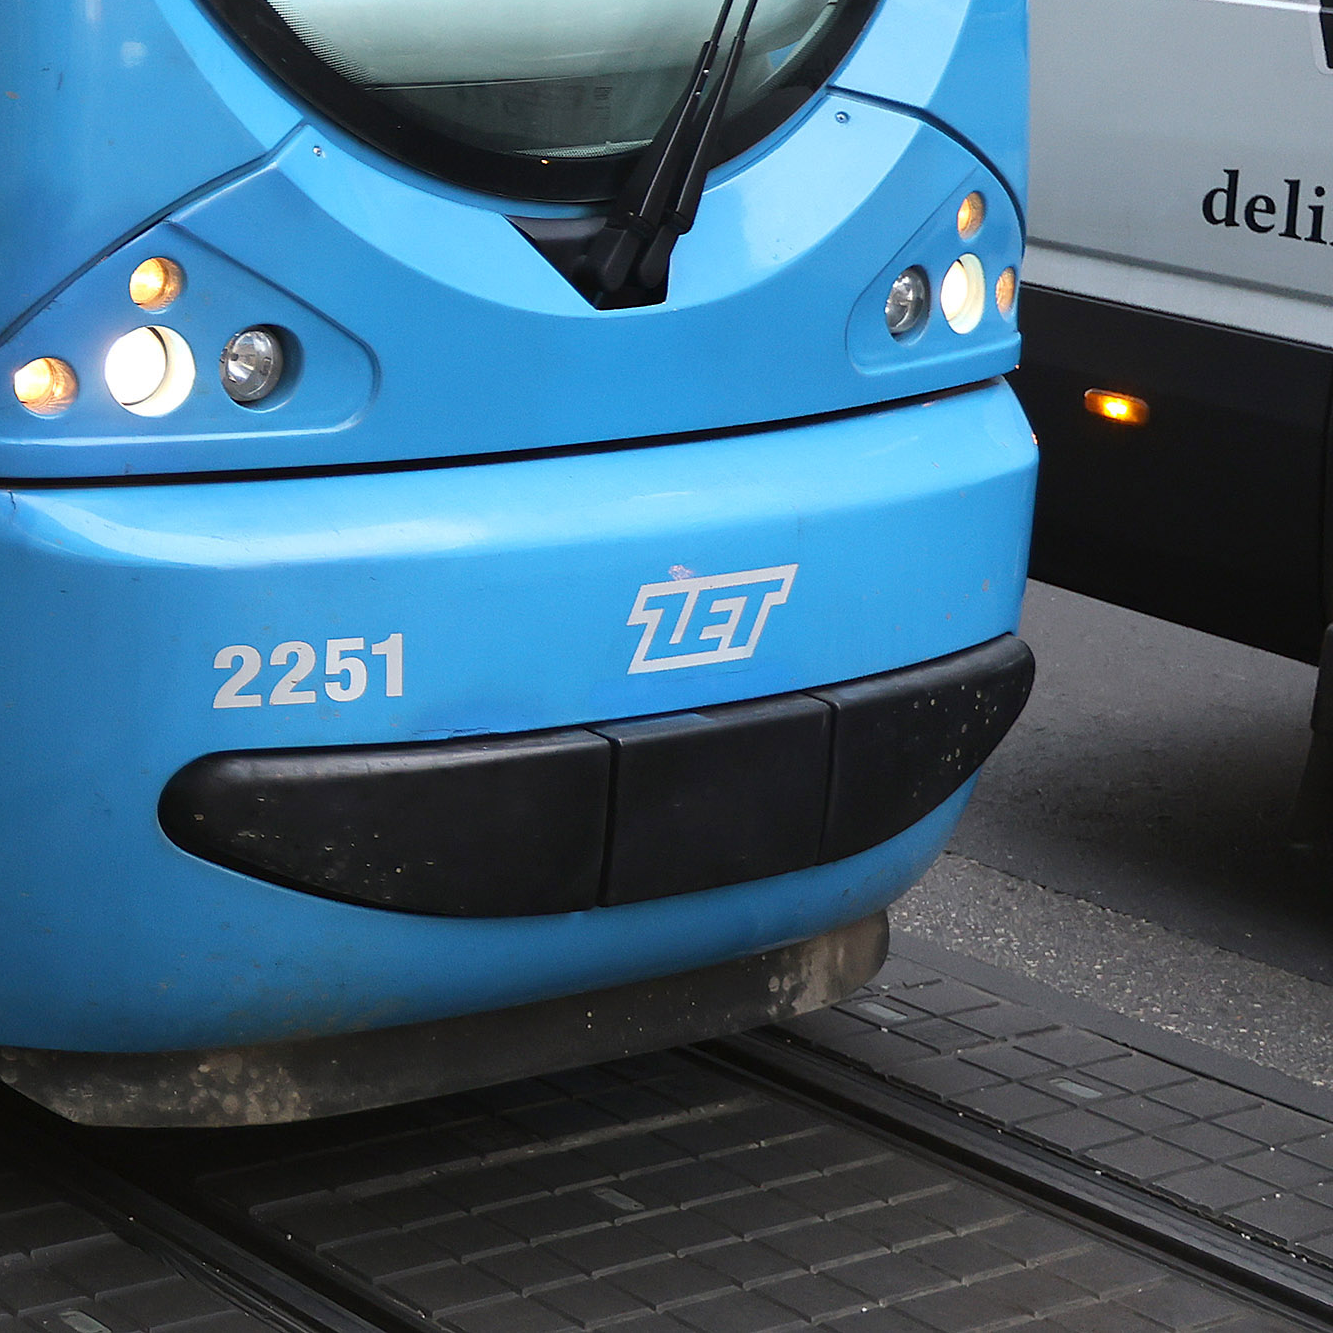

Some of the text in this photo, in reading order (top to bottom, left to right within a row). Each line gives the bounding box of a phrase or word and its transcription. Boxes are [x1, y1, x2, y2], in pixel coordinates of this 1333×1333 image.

[1202, 168, 1333, 246] deli
[626, 563, 799, 675] ZET
[212, 633, 404, 709] 2251
